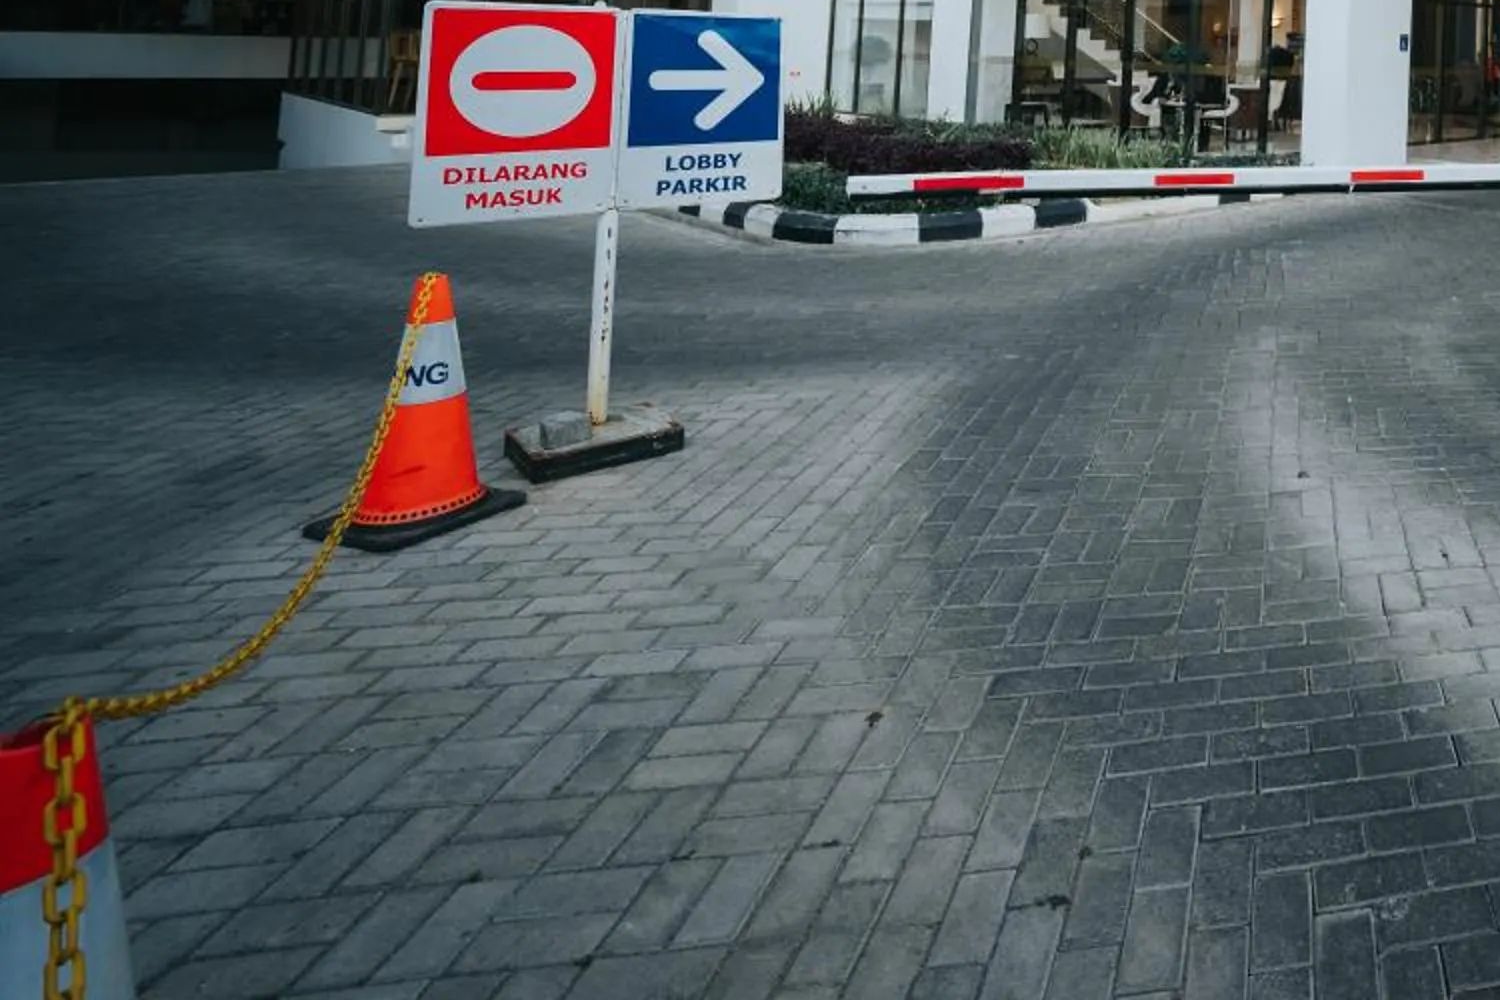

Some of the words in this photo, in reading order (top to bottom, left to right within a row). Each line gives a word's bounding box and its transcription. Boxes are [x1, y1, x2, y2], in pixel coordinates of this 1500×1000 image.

[664, 152, 743, 172] LOBBY
[443, 161, 588, 186] DILARANG
[656, 175, 747, 197] PARKIR
[465, 187, 563, 210] MASUK
